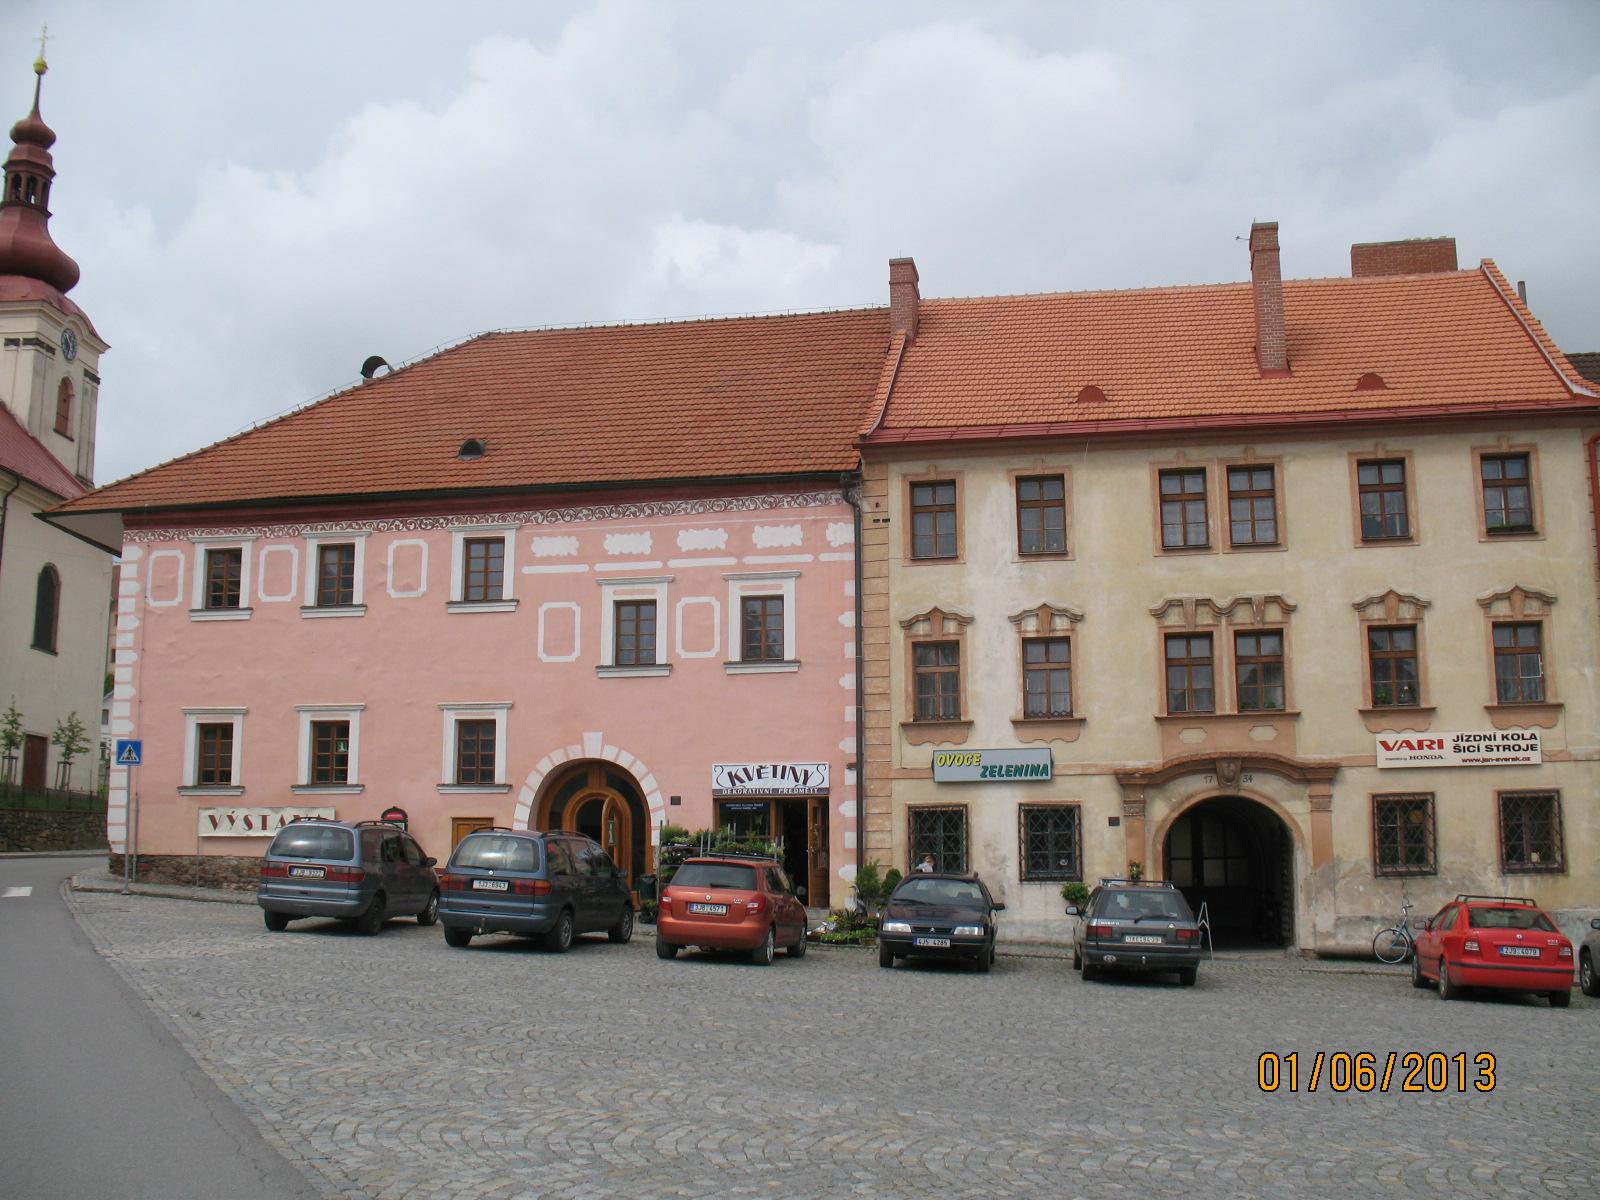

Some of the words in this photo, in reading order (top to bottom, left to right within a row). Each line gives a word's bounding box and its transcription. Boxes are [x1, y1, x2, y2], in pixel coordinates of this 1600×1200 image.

[1452, 732, 1497, 742] JÍZDNÍ
[1501, 733, 1538, 741] KOLA
[1379, 739, 1444, 751] VARI
[1453, 744, 1480, 753] ŠICÍ
[1485, 744, 1538, 752] STROJE
[937, 753, 981, 767] OVOCE
[727, 765, 814, 787] KVĚTINY
[980, 764, 1049, 778] ZELENINA
